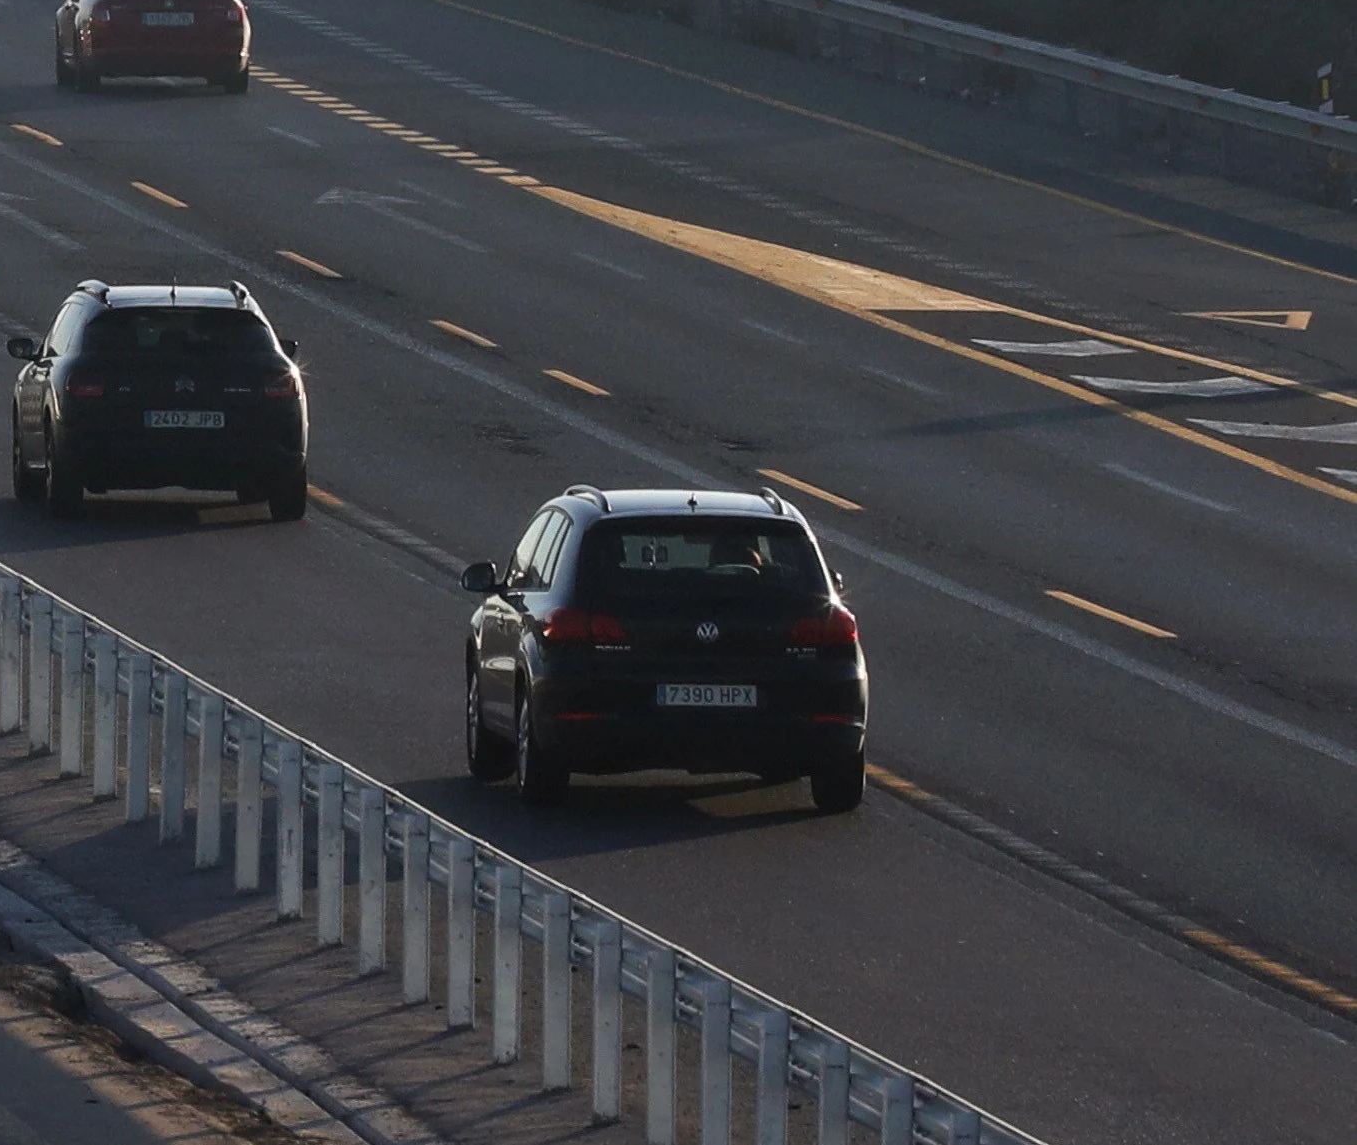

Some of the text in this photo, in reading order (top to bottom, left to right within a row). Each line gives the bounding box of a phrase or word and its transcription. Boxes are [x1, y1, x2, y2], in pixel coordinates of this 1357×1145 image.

[152, 413, 189, 427] 2402
[669, 686, 753, 705] 7390 HPX
